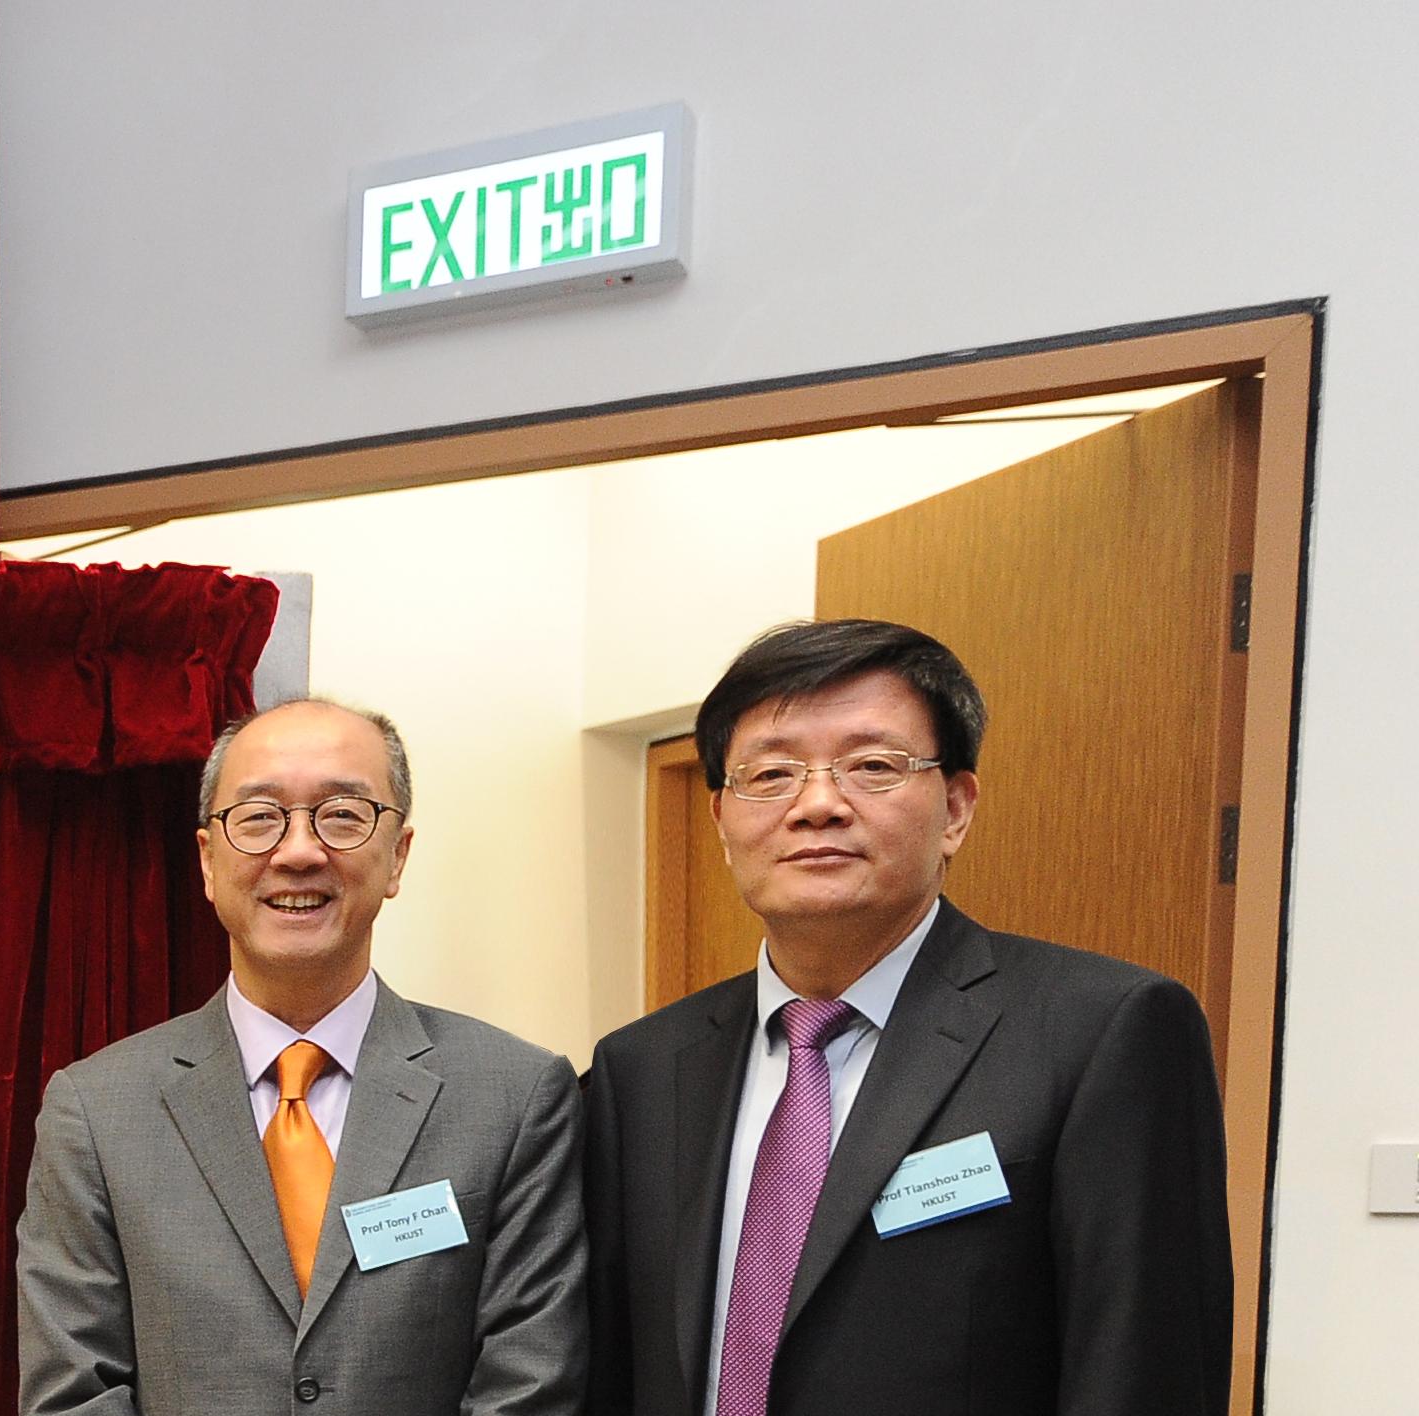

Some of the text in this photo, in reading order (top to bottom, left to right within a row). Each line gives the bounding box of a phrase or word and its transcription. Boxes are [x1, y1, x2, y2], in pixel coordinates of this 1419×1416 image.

[380, 152, 647, 294] EXIT 出口
[878, 1163, 992, 1204] Prof Tianshou Zhao
[921, 1191, 957, 1209] HKUST
[361, 1204, 449, 1236] Prof Tony F Chan
[394, 1228, 425, 1243] HKUST
